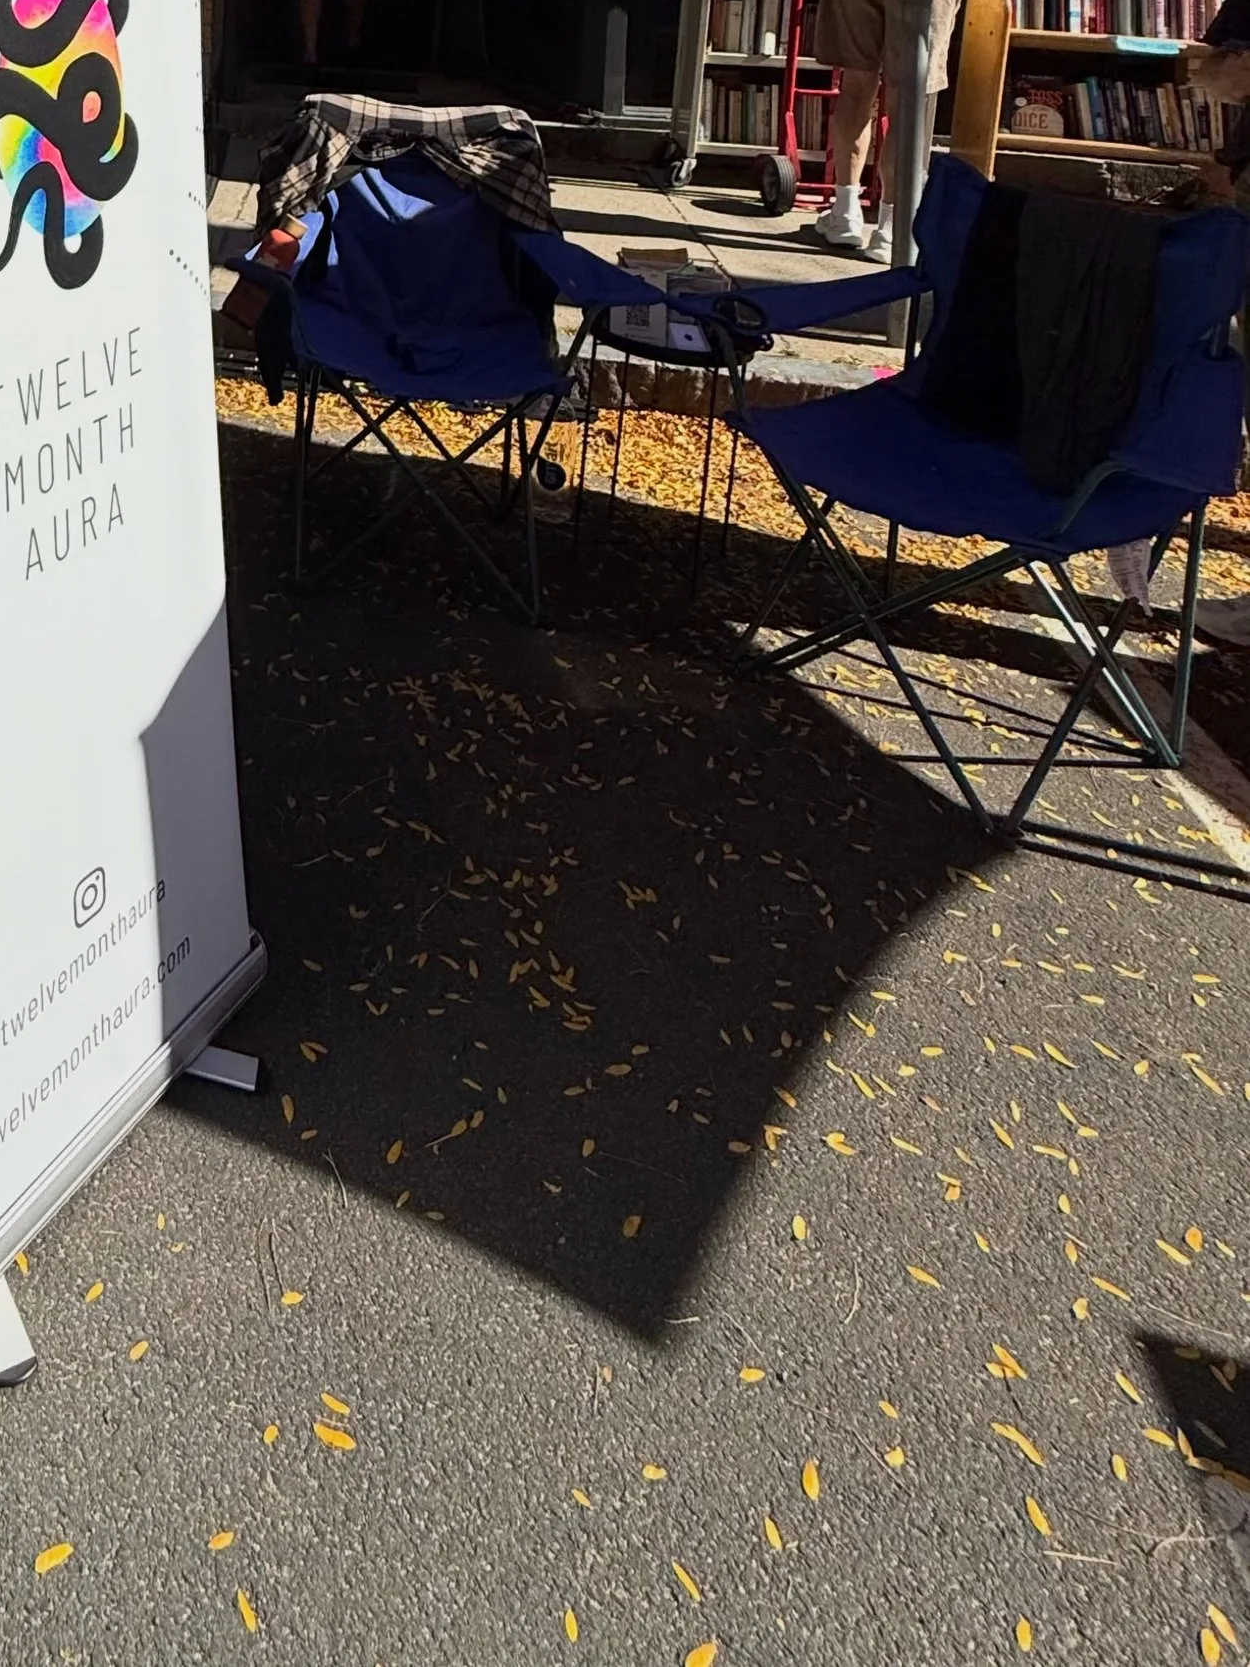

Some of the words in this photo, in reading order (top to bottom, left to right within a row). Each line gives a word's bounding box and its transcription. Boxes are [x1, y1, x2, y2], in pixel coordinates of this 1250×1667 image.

[1014, 112, 1048, 129] DICE
[5, 402, 134, 512] MONTH
[26, 483, 123, 581] AURA
[0, 879, 166, 1047] twelvemonthaura
